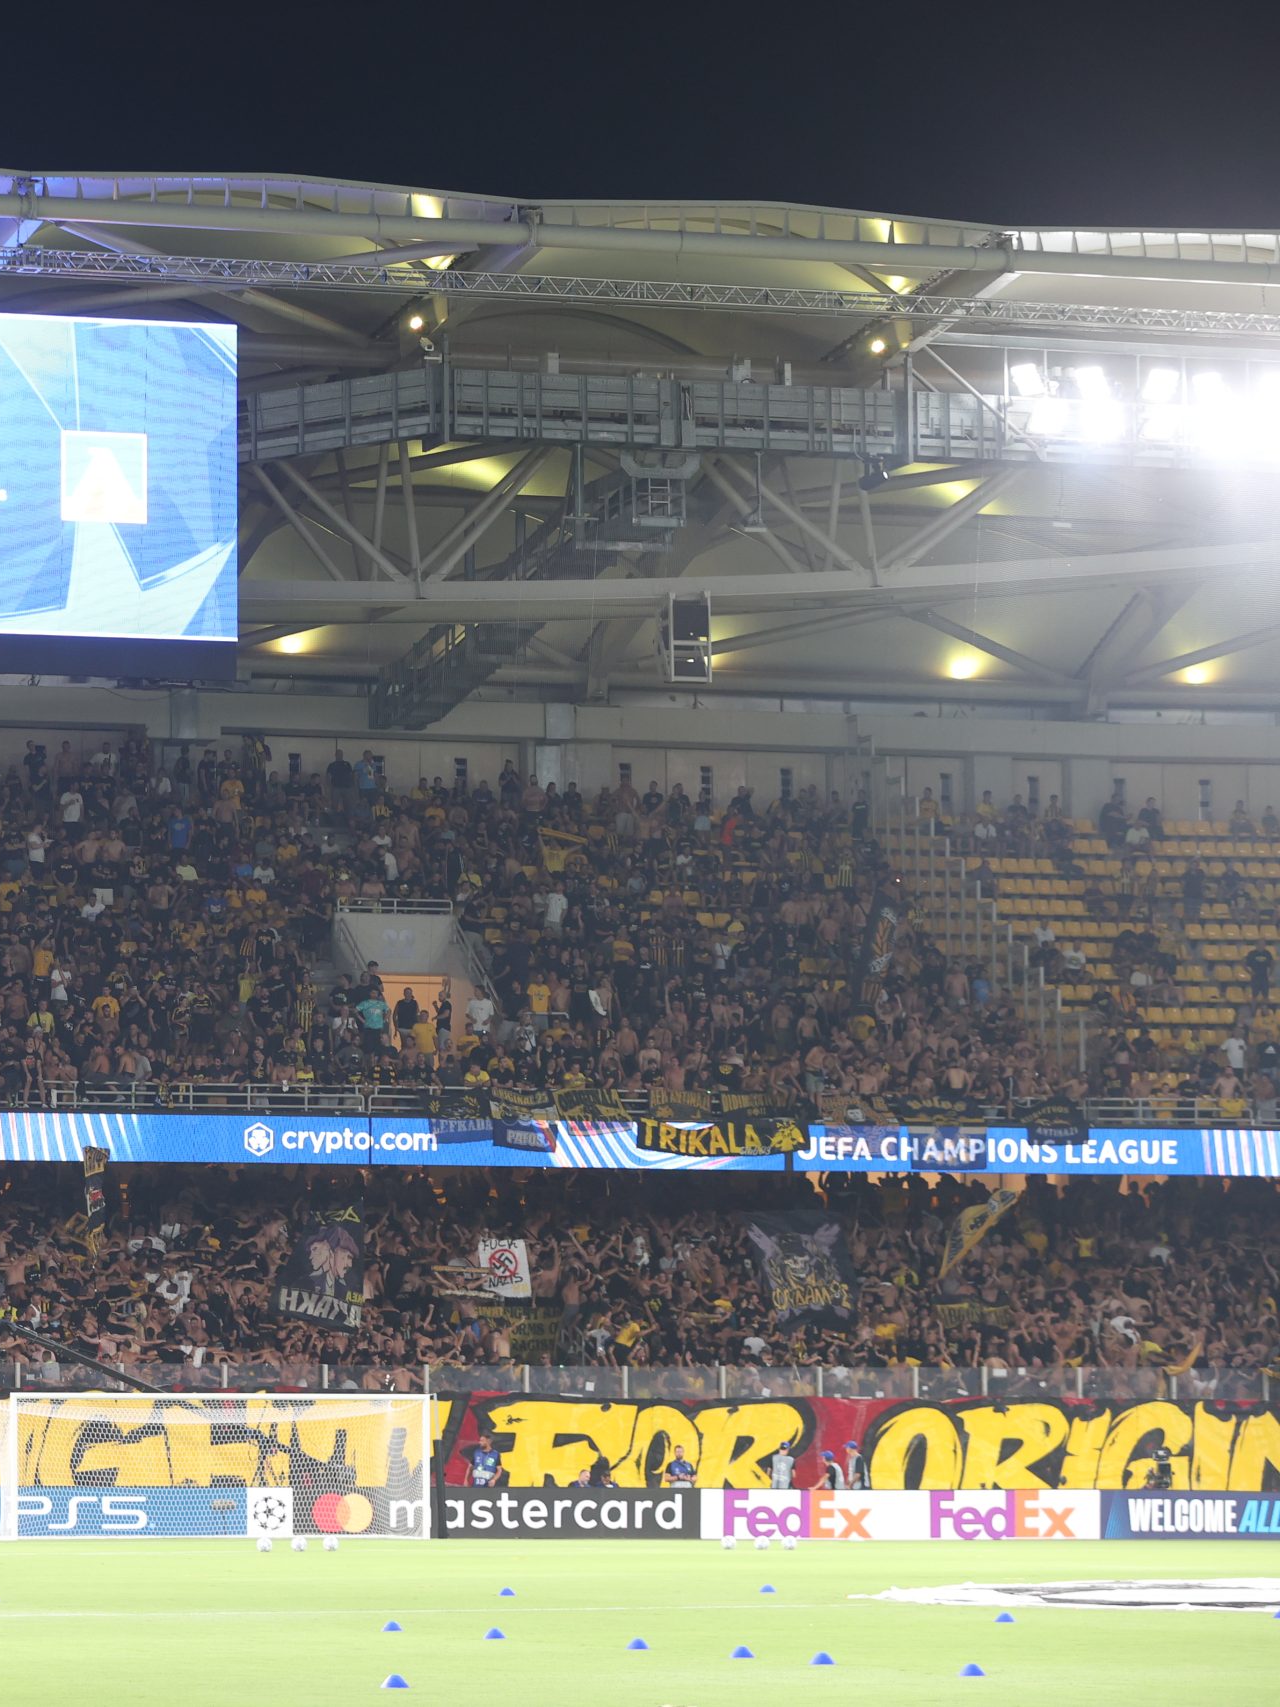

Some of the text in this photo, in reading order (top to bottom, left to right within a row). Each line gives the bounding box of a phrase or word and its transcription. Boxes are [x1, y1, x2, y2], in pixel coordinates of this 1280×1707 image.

[281, 1127, 438, 1153] crypto.com
[640, 1117, 762, 1155] TRIKALA
[880, 1136, 1058, 1163] CHAMPIONS
[1065, 1138, 1178, 1165] LEAGUE
[488, 1275, 524, 1289] NAZIS
[487, 1400, 804, 1488] FOR
[16, 1495, 148, 1531] PS5
[389, 1492, 684, 1530] mastercard
[723, 1490, 872, 1539] FedEx
[930, 1490, 1076, 1540] FedEx
[1128, 1498, 1237, 1534] WELCOME
